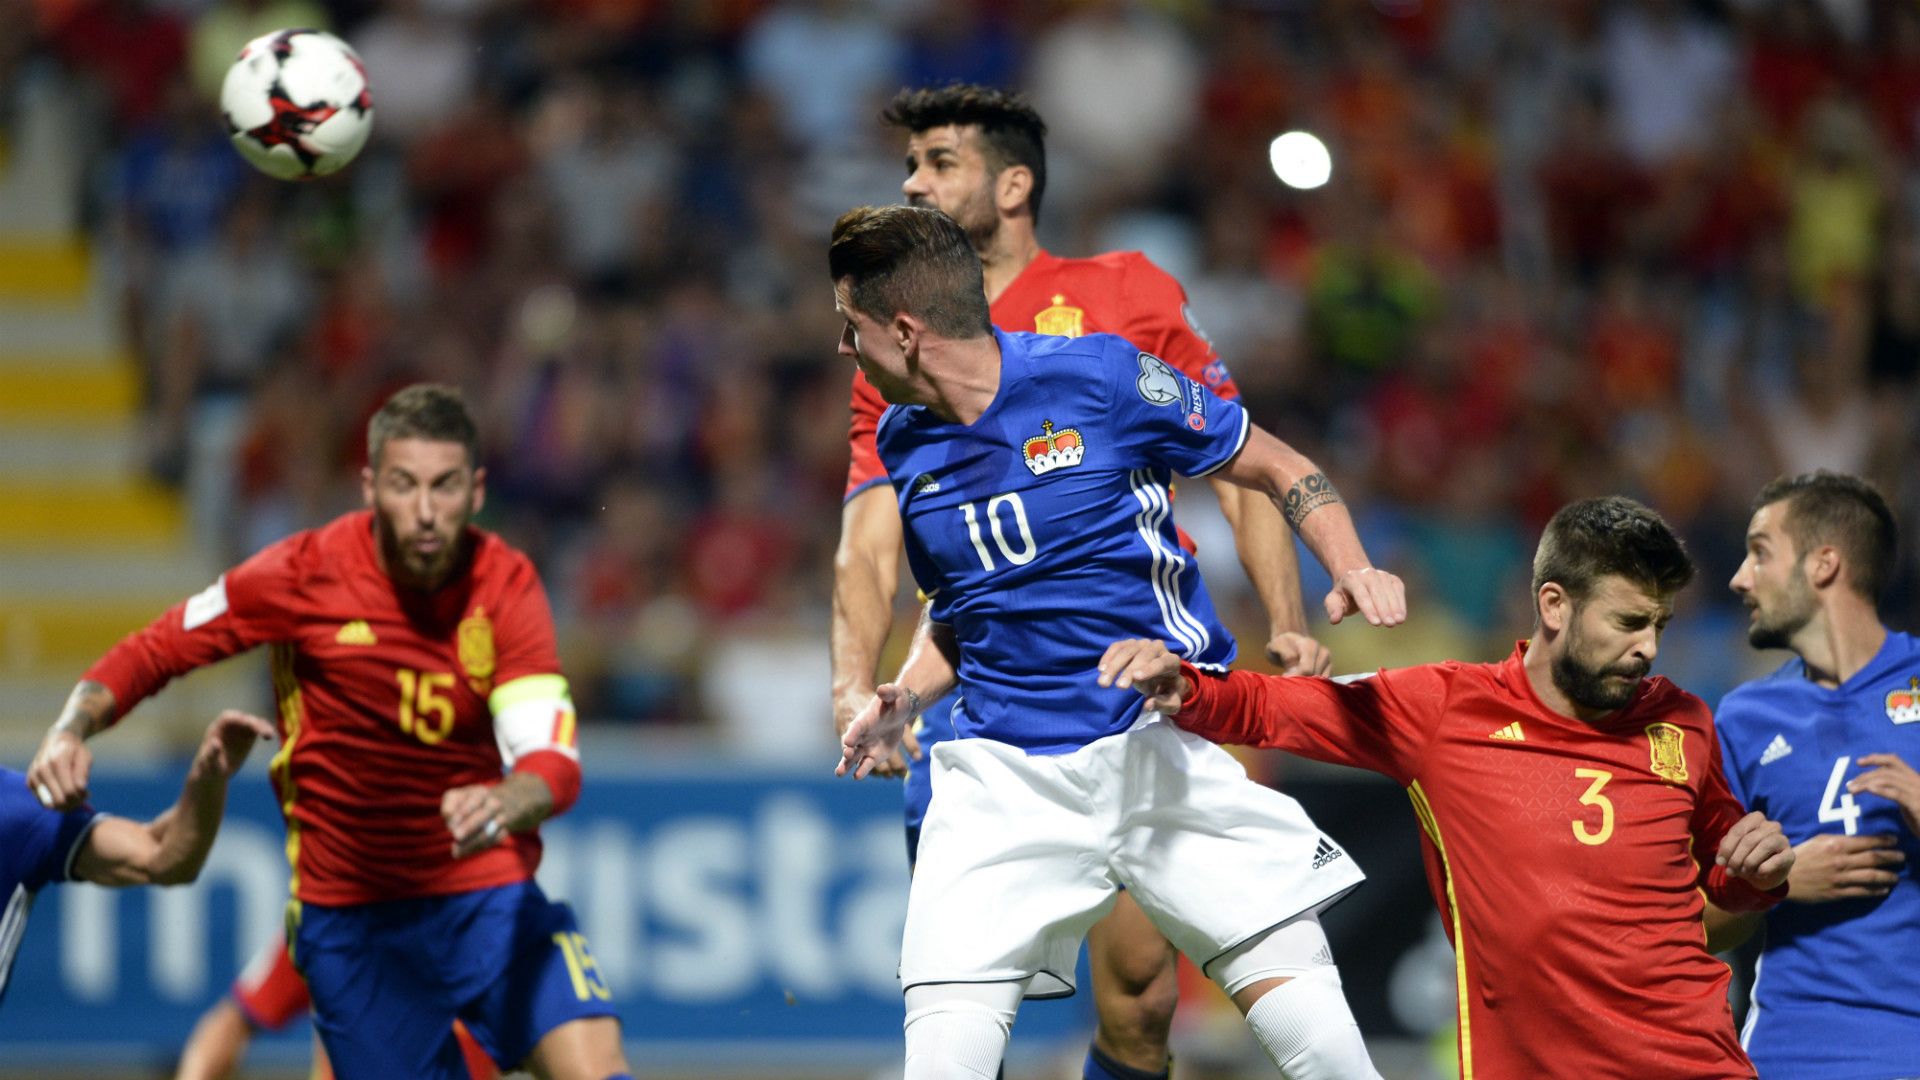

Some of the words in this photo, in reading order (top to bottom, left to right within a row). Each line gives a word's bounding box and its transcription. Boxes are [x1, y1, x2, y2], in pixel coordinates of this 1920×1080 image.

[1190, 379, 1202, 413] RESPEC
[959, 492, 1036, 572] 10
[397, 669, 456, 744] 15
[1572, 768, 1615, 845] 3
[1818, 756, 1861, 835] 4
[1312, 849, 1342, 870] adidas
